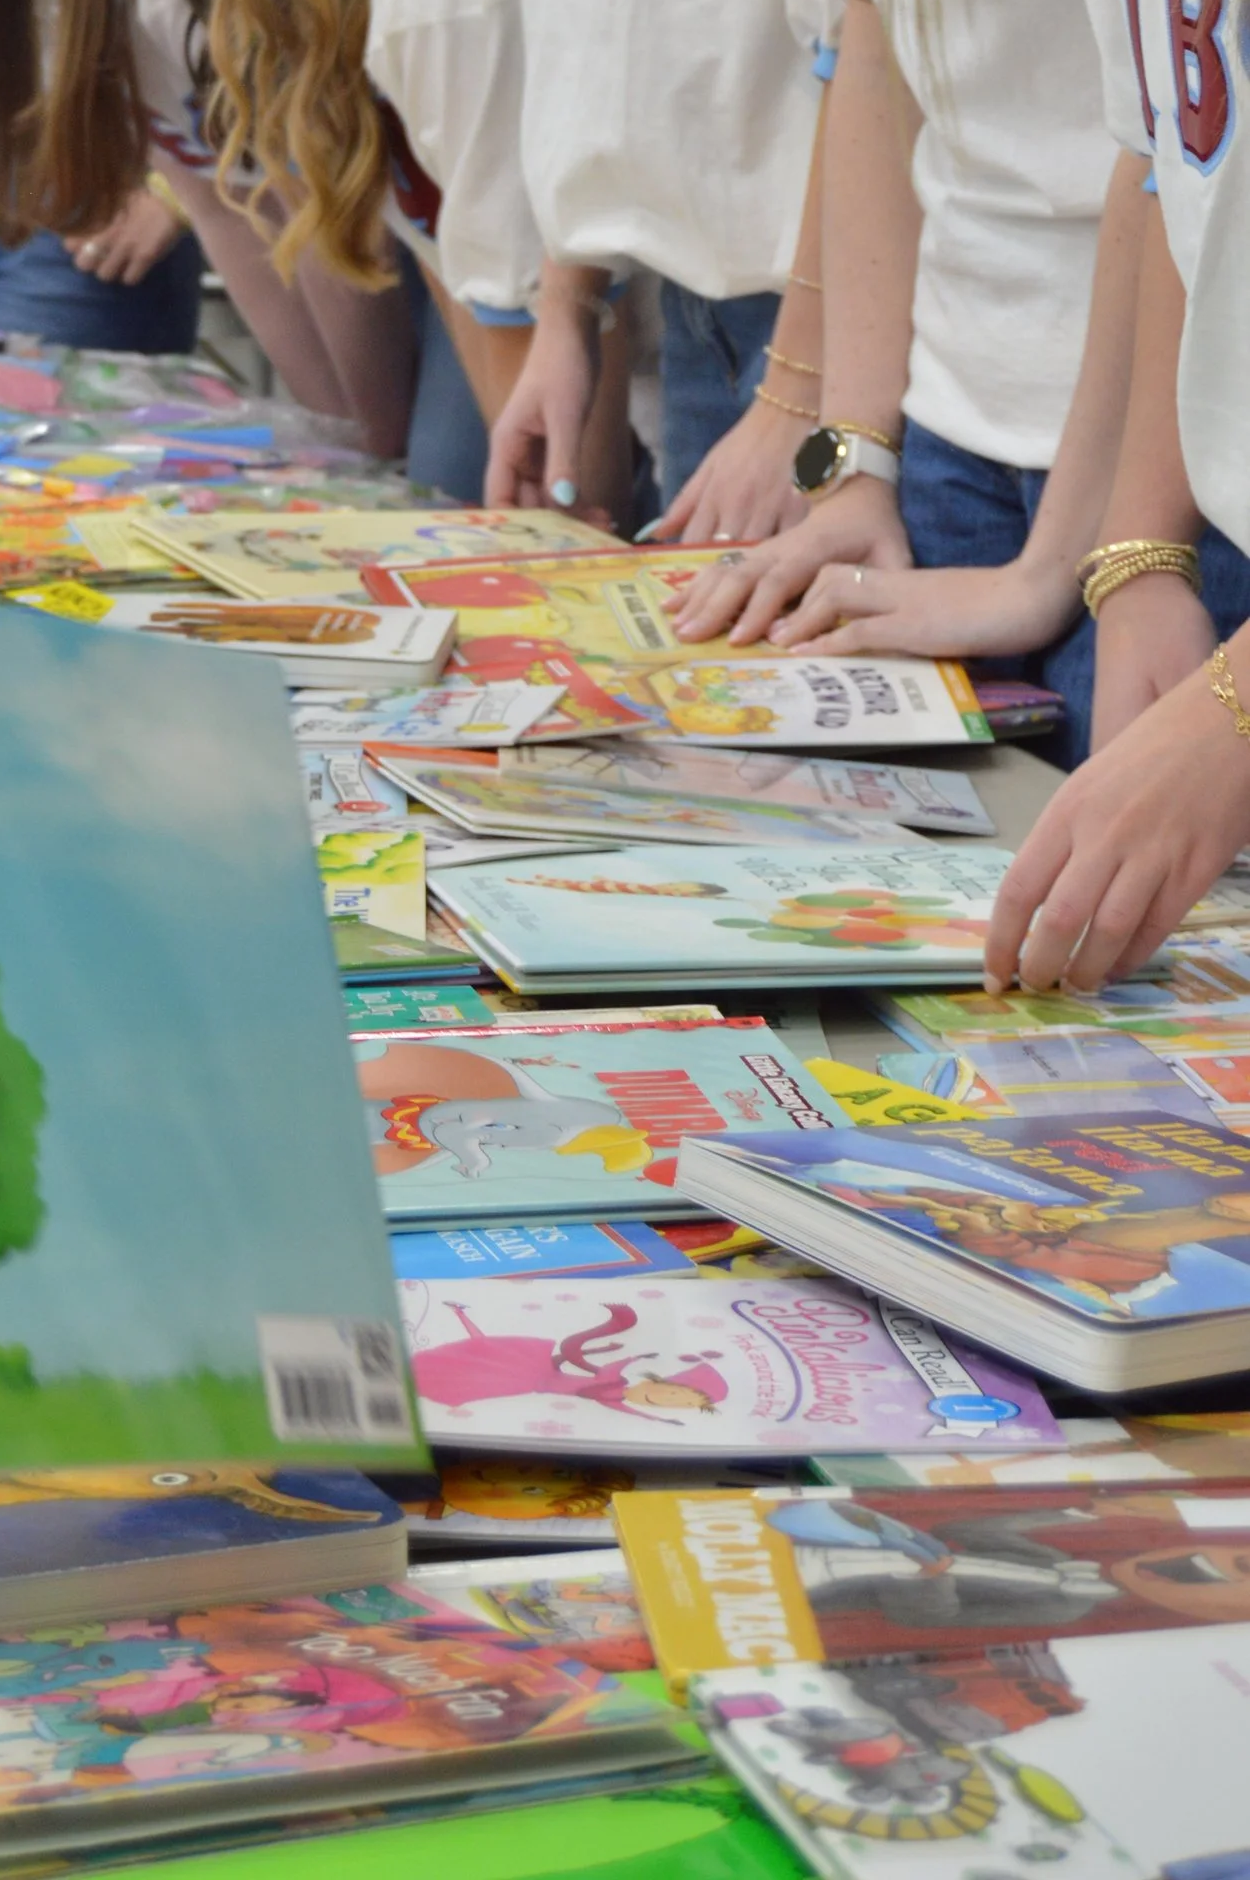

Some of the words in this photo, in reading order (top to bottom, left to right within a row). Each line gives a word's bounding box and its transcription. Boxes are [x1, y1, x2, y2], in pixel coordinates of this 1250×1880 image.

[742, 1054, 784, 1078] Little
[762, 1076, 812, 1111] Library
[913, 1127, 1145, 1197] pajama
[1072, 1126, 1244, 1178] llama
[751, 1298, 887, 1426] Pinkalicious
[888, 1316, 932, 1346] Can
[912, 1342, 973, 1393] Read!
[953, 1403, 997, 1412] 1
[676, 1499, 774, 1587] MOLLY
[711, 1593, 799, 1661] MAC
